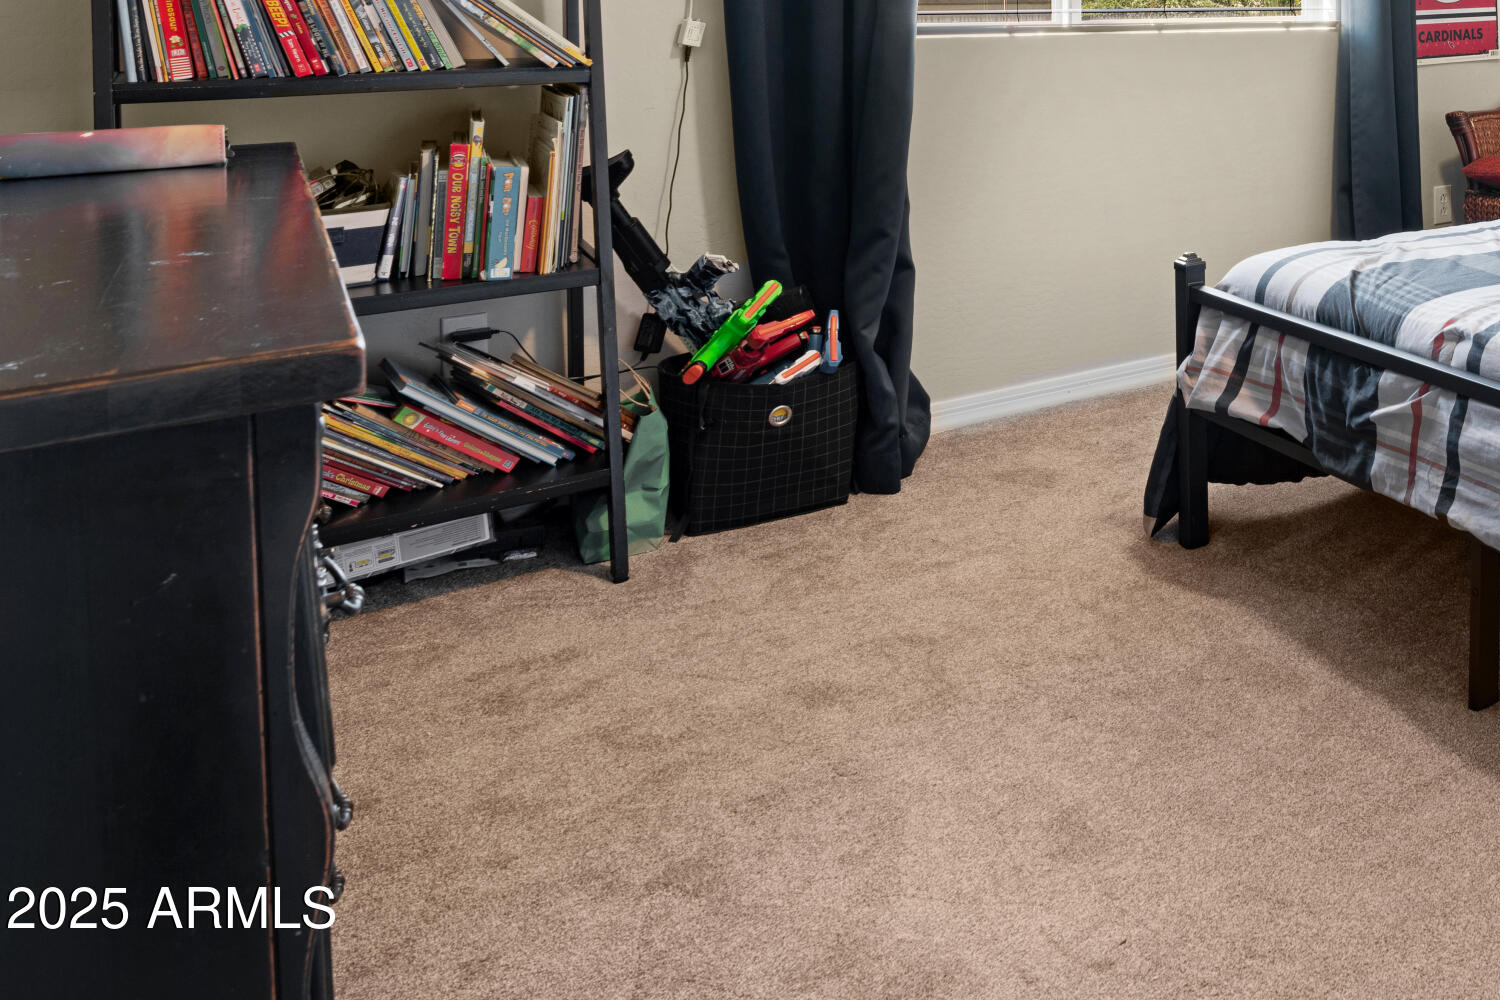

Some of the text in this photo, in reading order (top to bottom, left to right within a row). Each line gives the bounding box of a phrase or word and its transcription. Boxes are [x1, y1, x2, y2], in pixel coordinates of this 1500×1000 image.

[1418, 28, 1483, 43] CARDINALS
[451, 172, 463, 192] OUR
[447, 225, 460, 253] TOWN
[335, 473, 371, 491] Christmas
